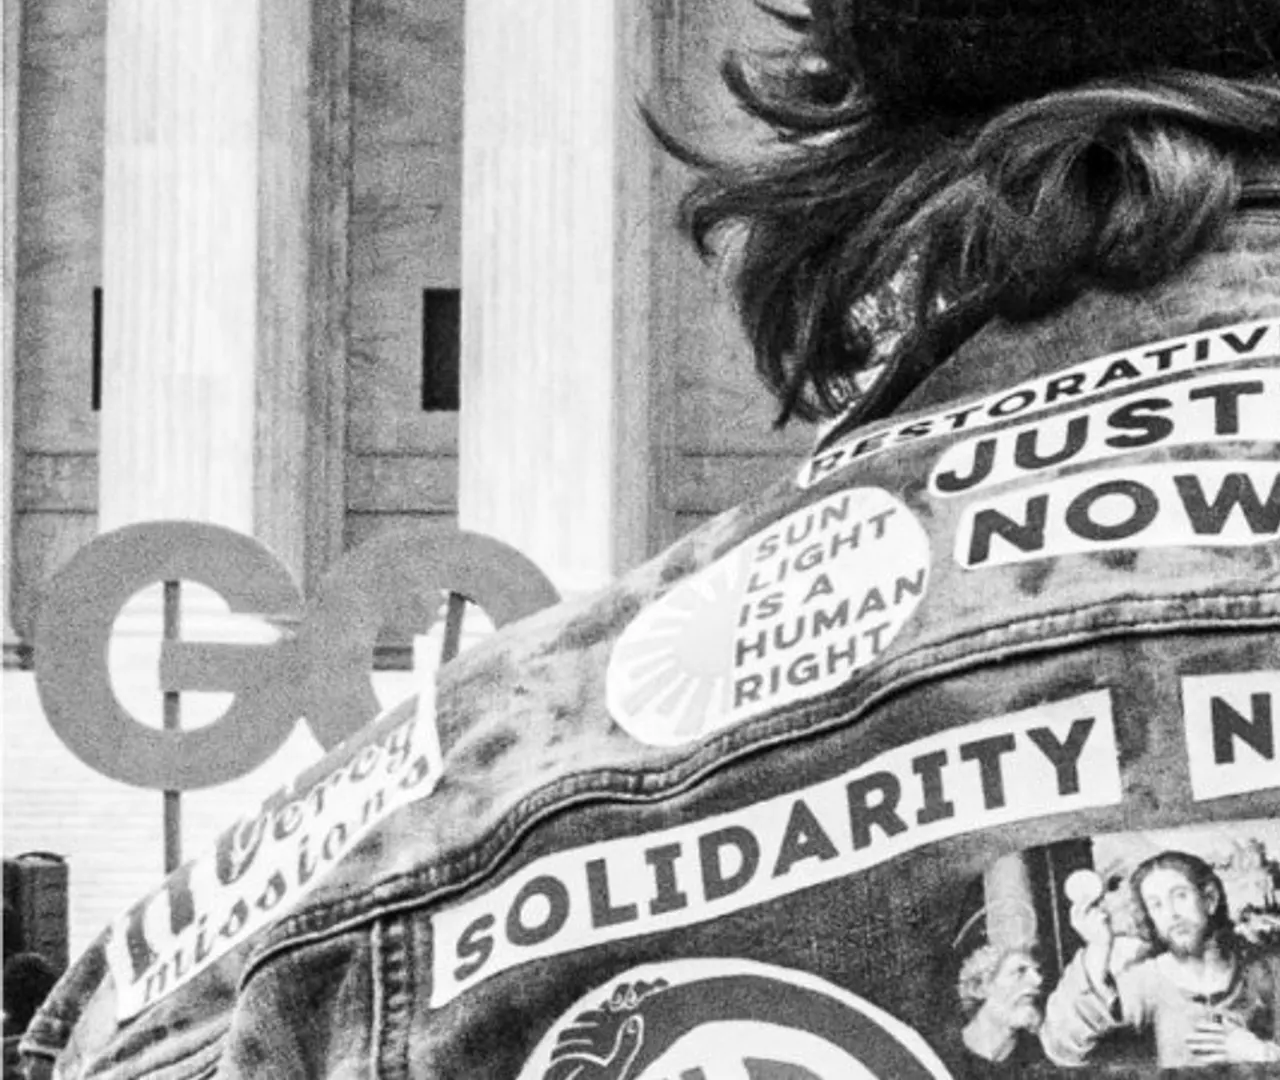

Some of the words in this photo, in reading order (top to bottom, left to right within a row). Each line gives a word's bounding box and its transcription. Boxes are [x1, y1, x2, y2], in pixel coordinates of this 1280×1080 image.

[748, 507, 897, 594] LIGHT
[755, 495, 850, 563] SUN
[734, 568, 926, 668] HUMAN
[738, 592, 784, 628] IS
[802, 573, 835, 604] A
[732, 622, 891, 709] RIGHT
[454, 717, 1097, 984] SOLIDARITY
